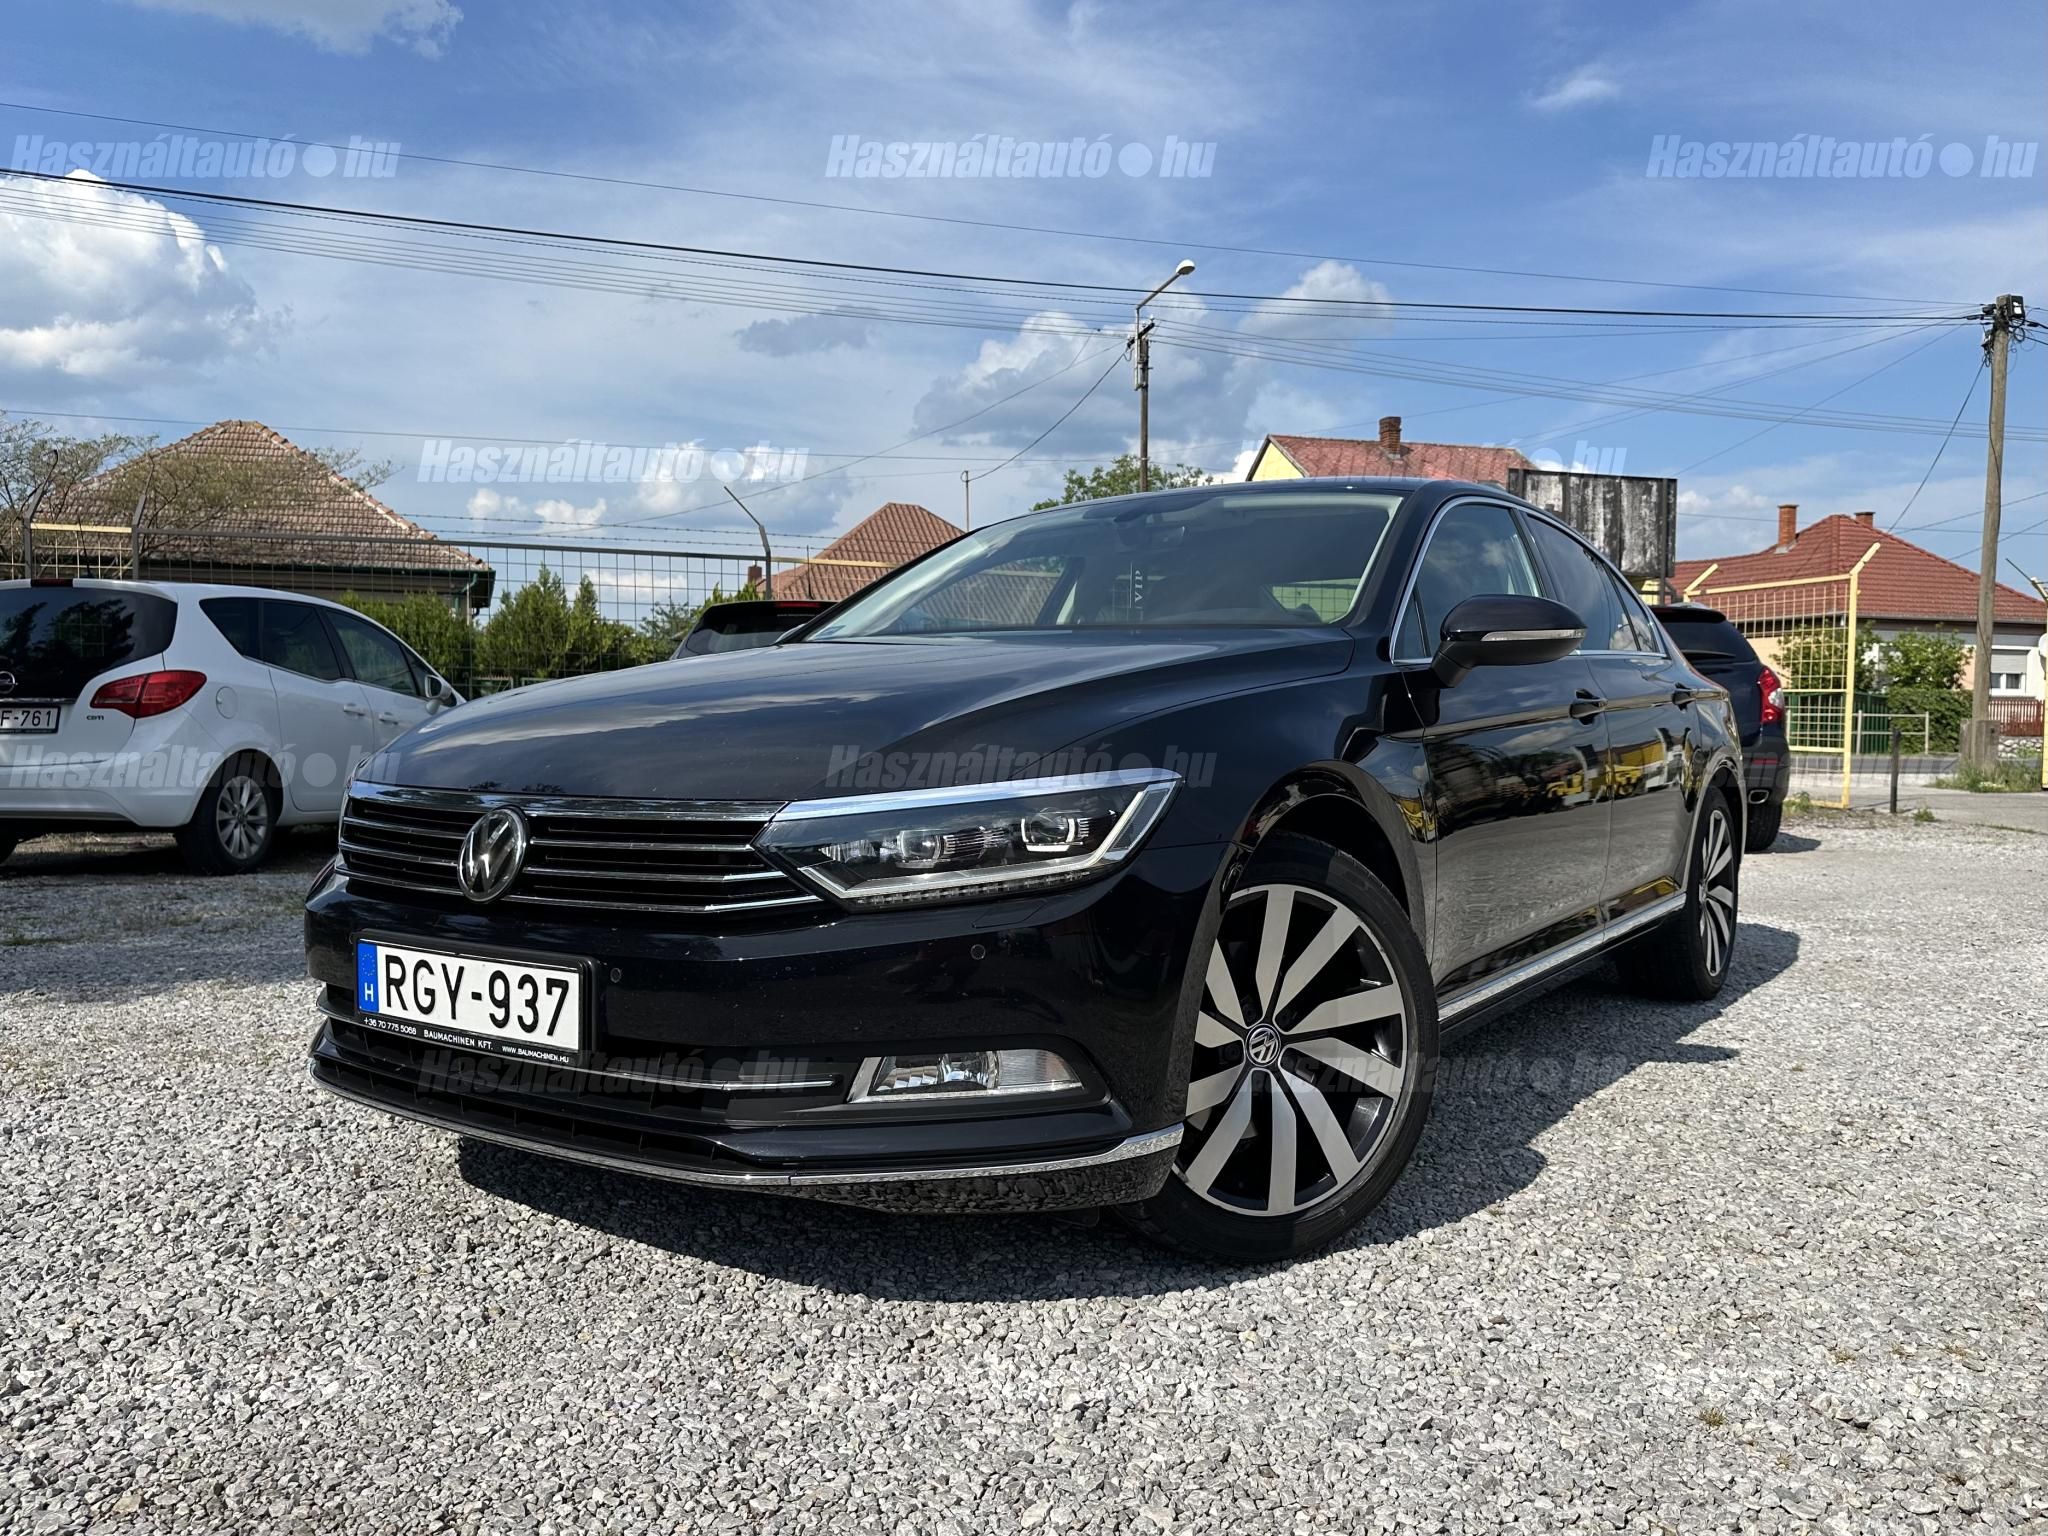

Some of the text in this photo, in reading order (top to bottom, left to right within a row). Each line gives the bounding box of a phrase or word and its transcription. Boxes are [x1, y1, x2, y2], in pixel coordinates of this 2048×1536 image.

[363, 981, 375, 1003] H
[384, 954, 570, 1037] RGY-937
[423, 1029, 475, 1047] BAUMACHINEN
